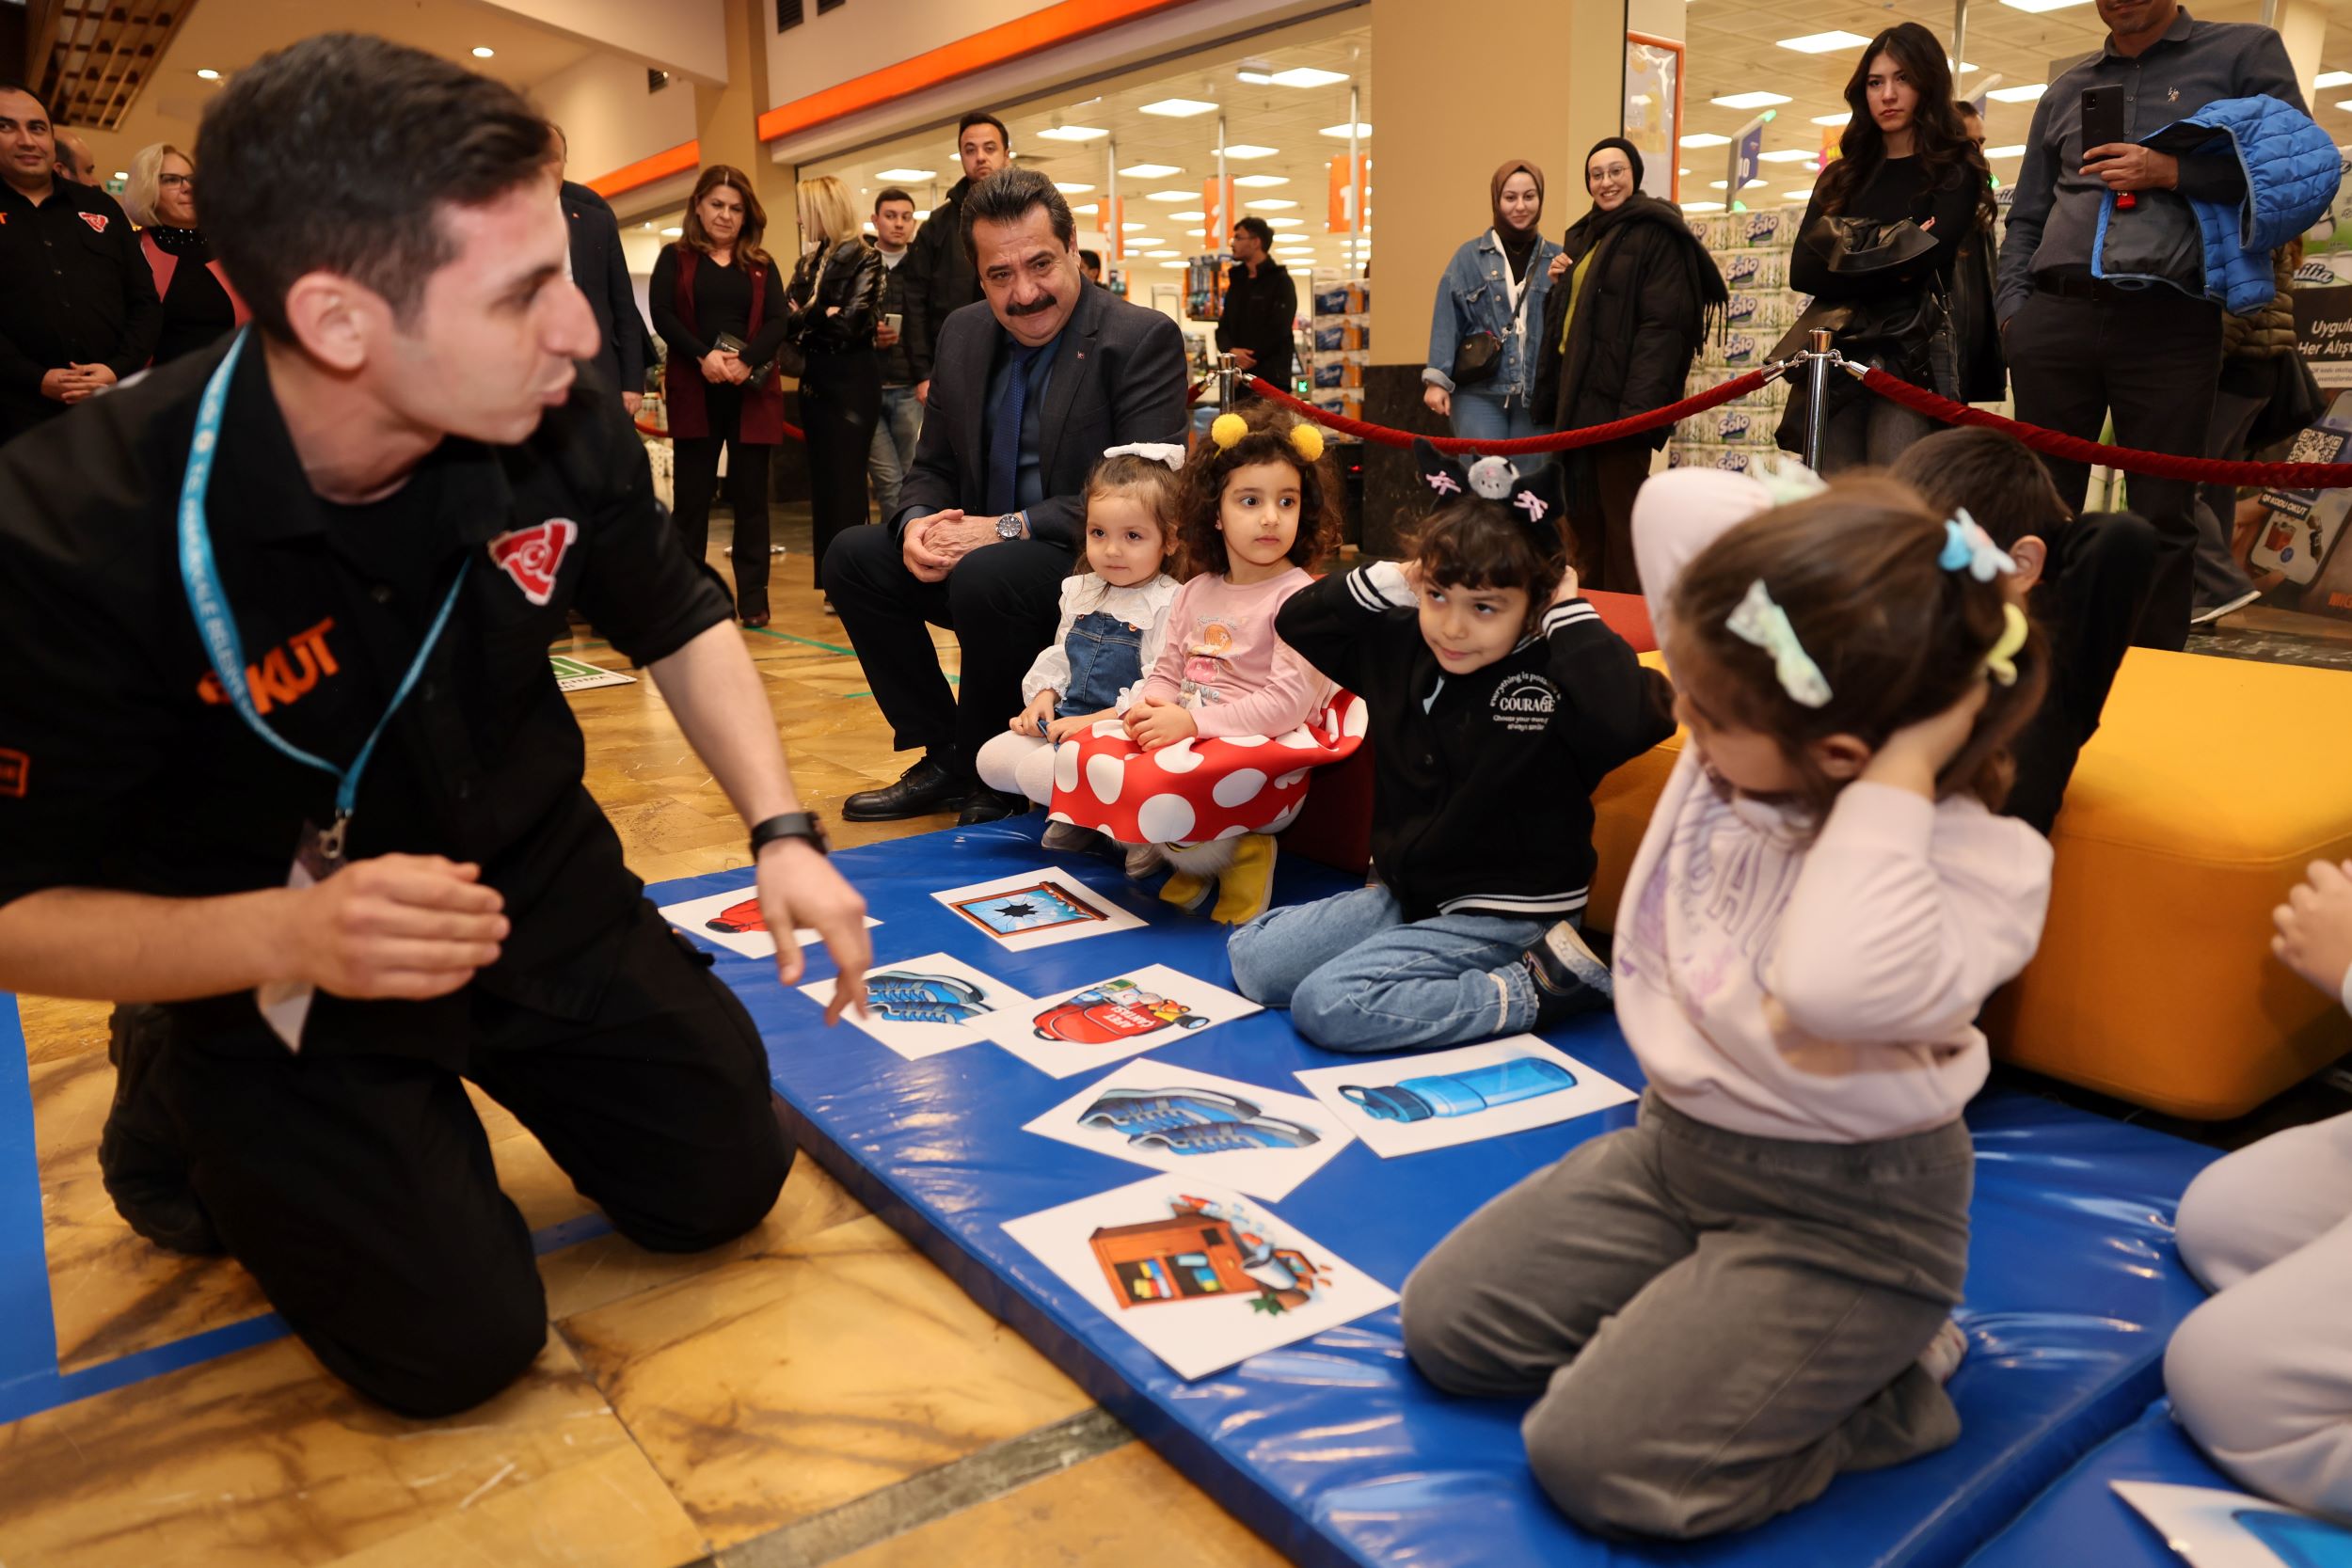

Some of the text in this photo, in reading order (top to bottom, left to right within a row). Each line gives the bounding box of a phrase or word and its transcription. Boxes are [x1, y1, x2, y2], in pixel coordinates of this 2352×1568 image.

[1746, 215, 1779, 241] Solo
[1726, 258, 1759, 281] Solo
[1724, 337, 1755, 358] Solo
[2298, 341, 2323, 356] Her
[1718, 415, 1750, 436] Solo
[1500, 695, 1555, 712] COURAGE
